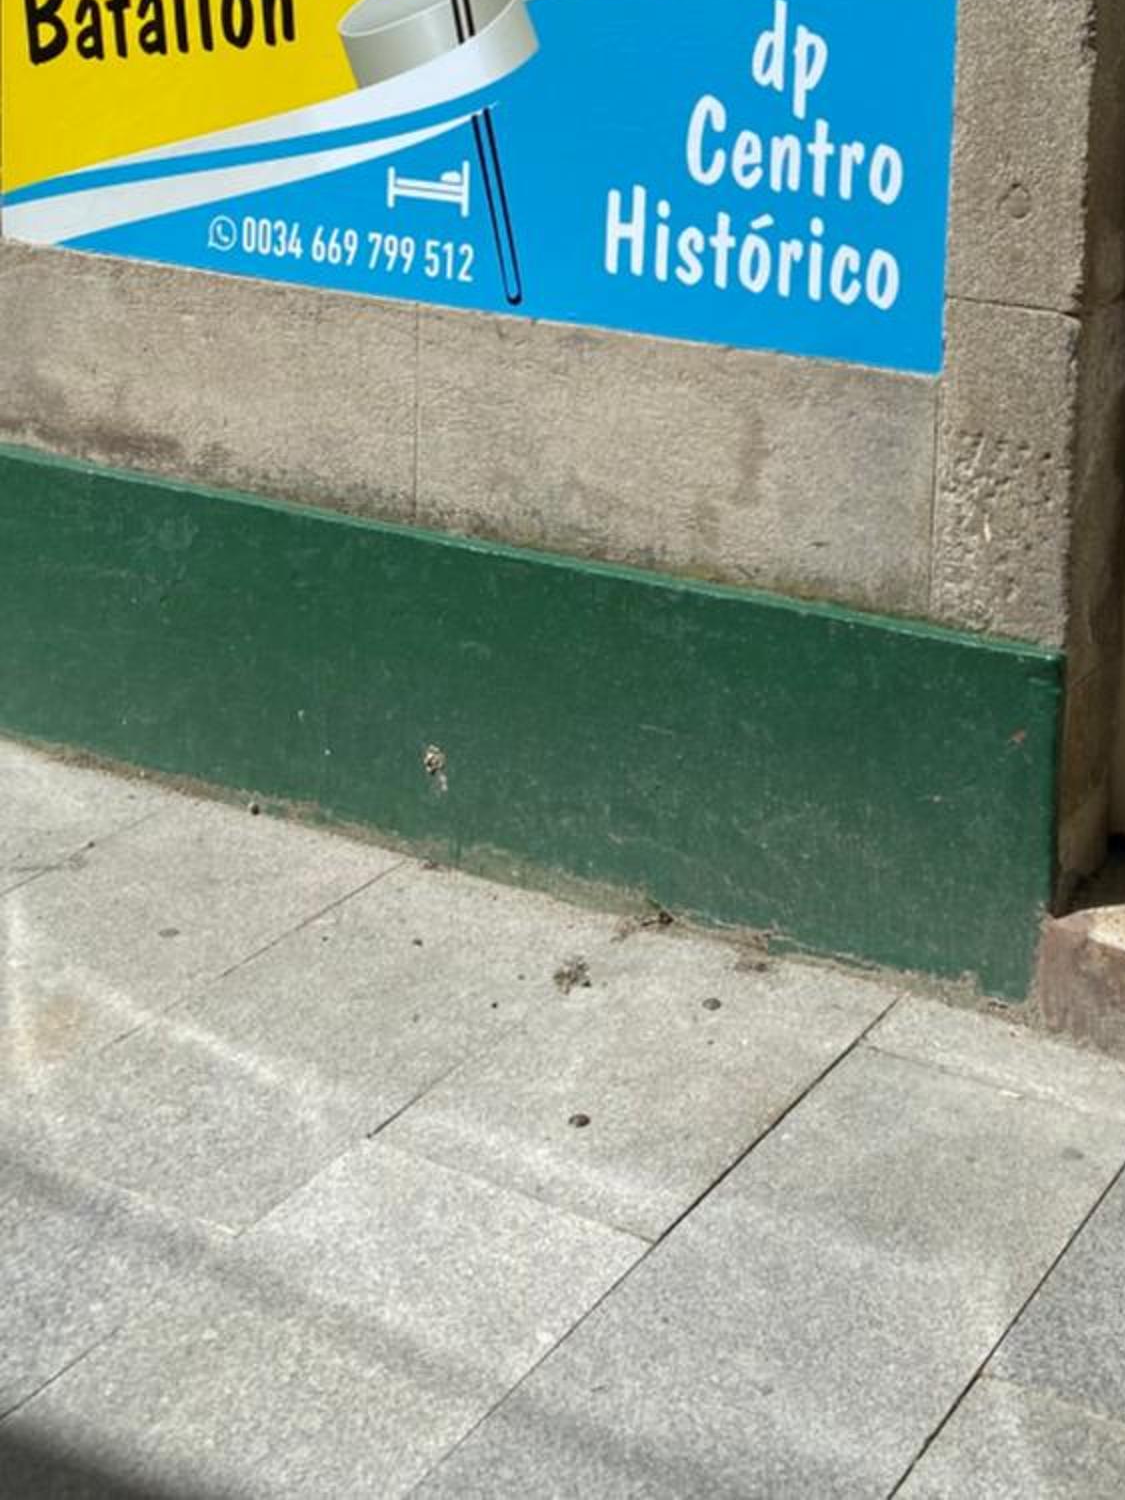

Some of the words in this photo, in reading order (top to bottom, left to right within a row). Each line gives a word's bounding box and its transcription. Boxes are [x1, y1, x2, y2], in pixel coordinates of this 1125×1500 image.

[686, 94, 904, 206] Centro
[241, 215, 304, 260] 0034
[311, 225, 359, 267] 669
[367, 232, 416, 275] 799
[423, 239, 475, 283] 512
[604, 183, 901, 311] Histórico
